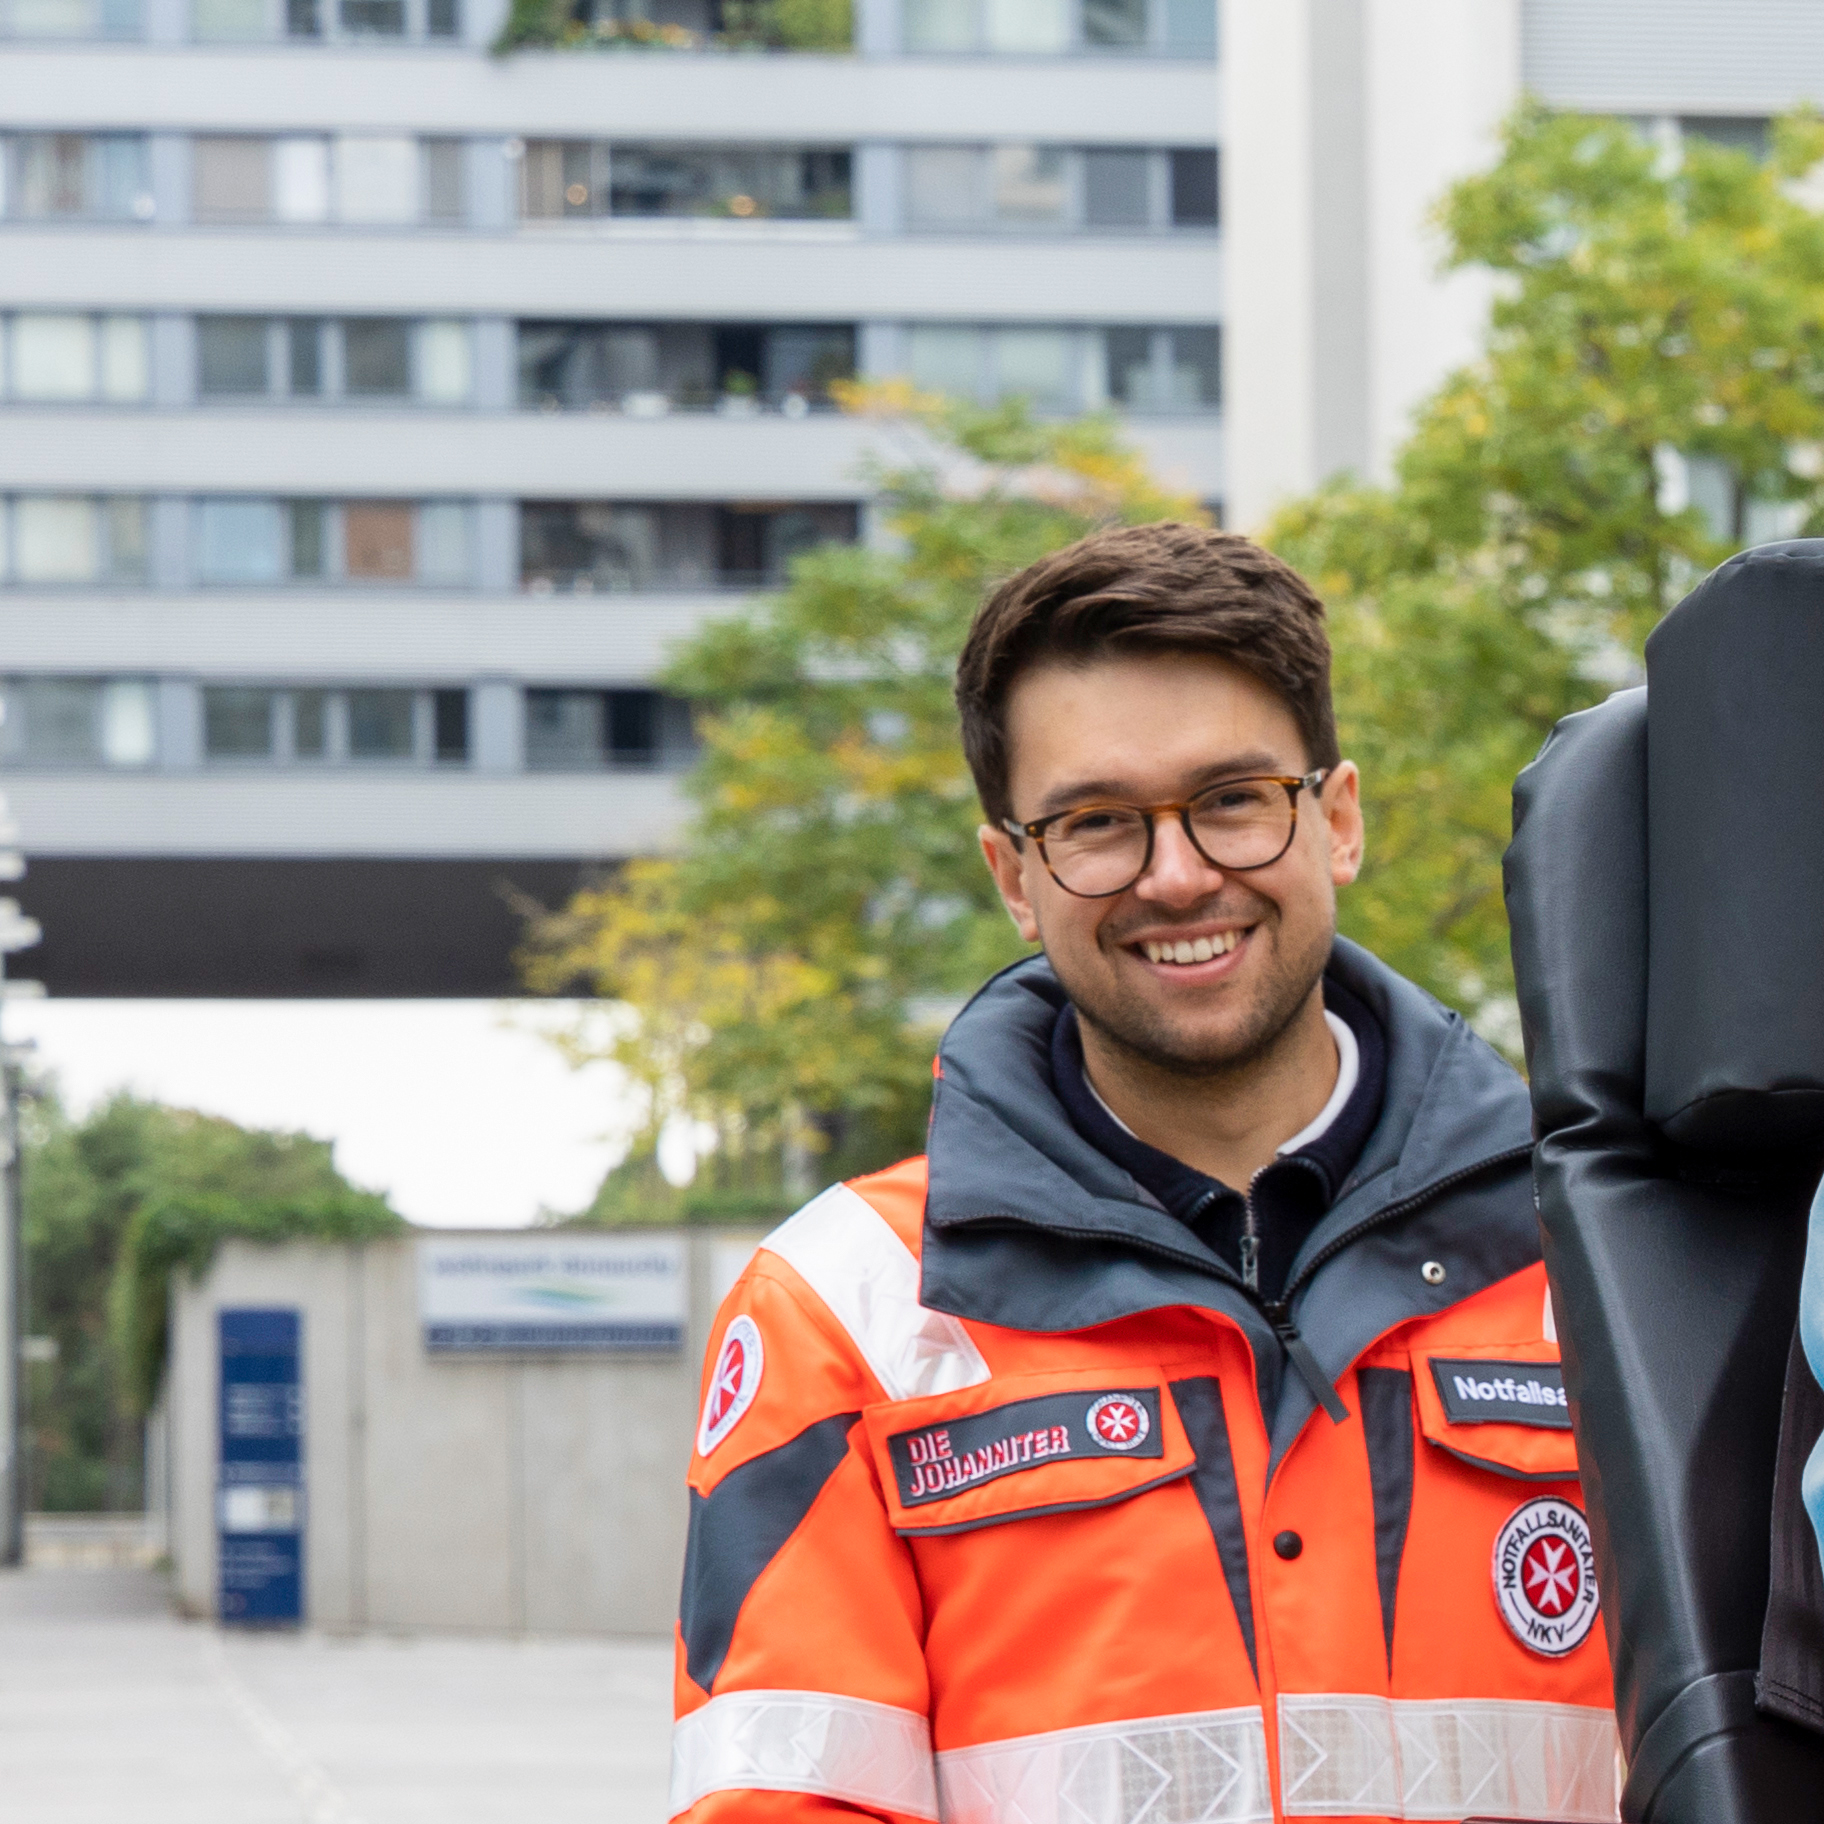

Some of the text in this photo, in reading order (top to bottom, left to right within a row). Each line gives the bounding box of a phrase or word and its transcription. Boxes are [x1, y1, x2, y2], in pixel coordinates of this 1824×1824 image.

[1453, 1375, 1568, 1407] Notfallsa
[906, 1429, 952, 1466] DIE
[910, 1425, 1072, 1497] JOHANNITER
[1527, 1618, 1565, 1644] NKV
